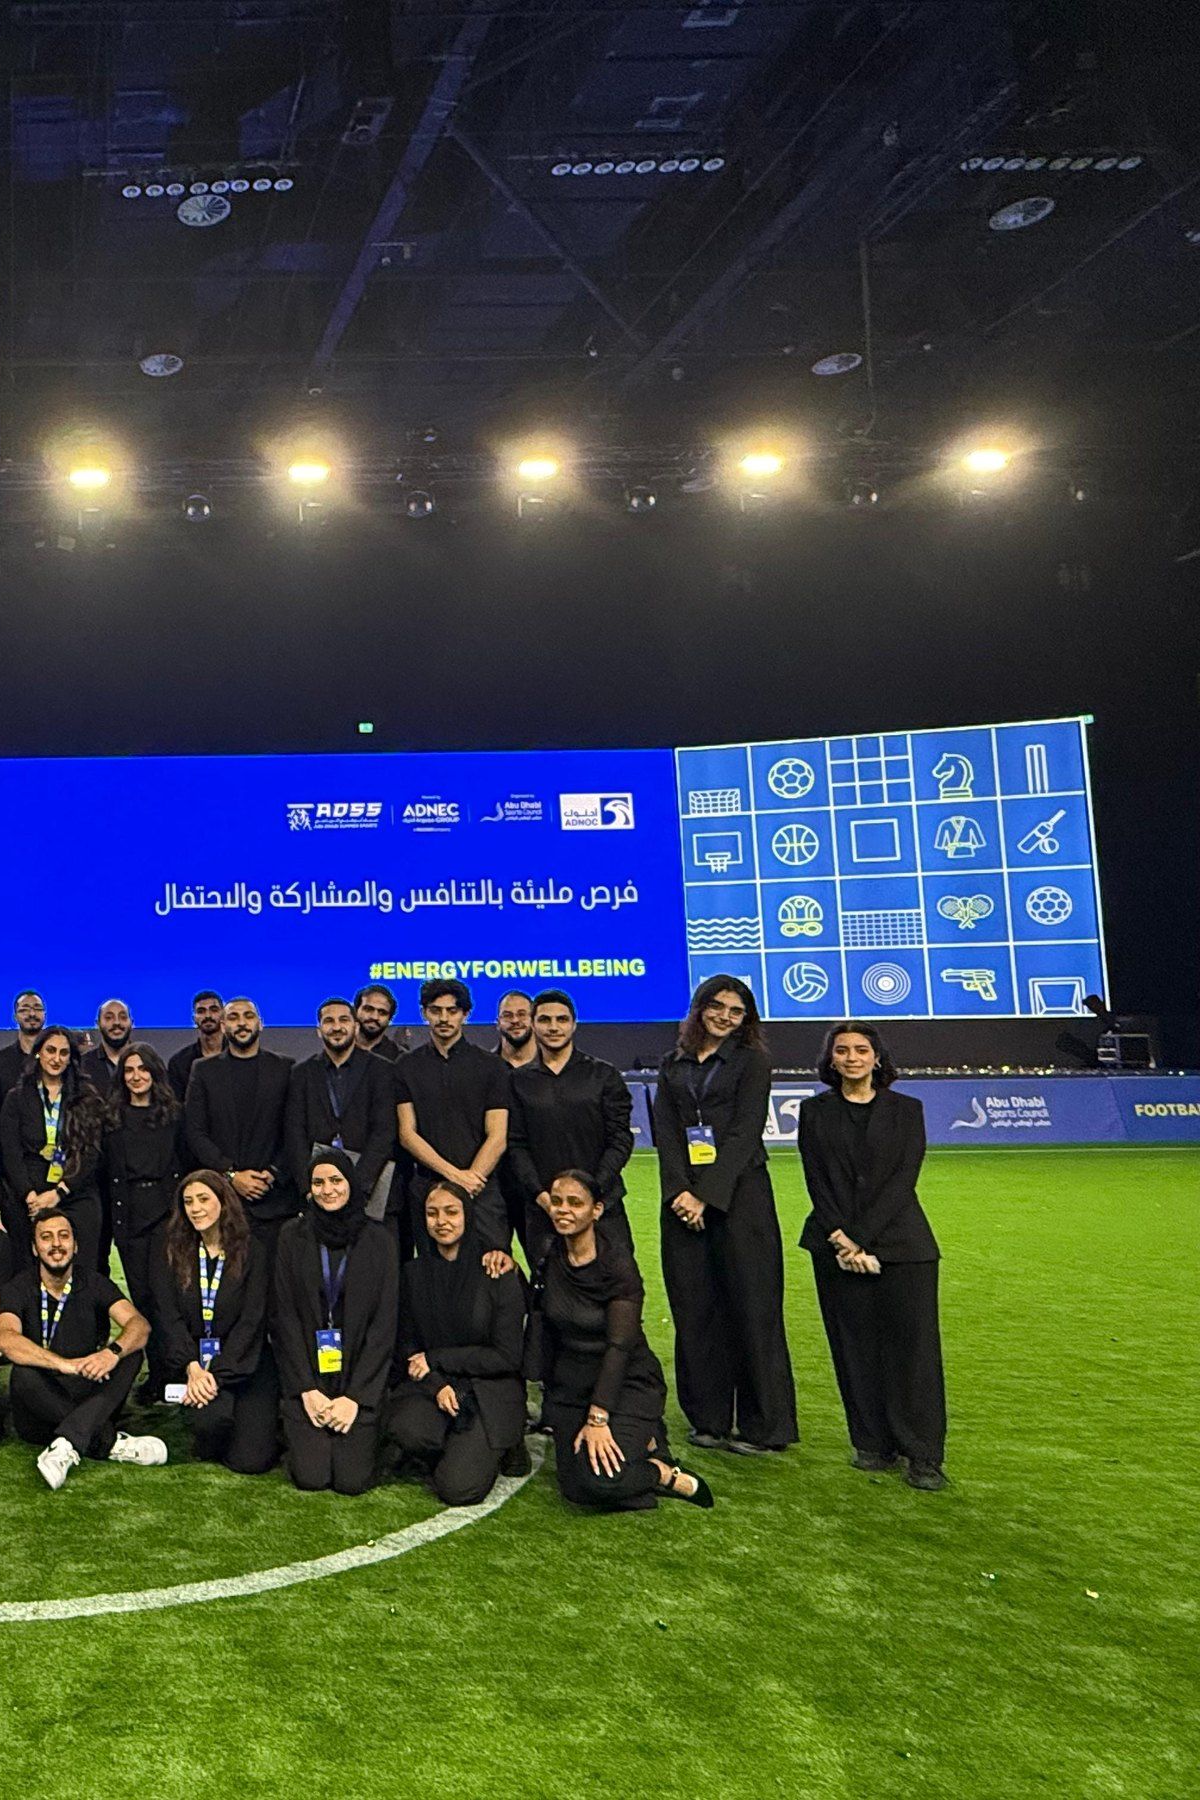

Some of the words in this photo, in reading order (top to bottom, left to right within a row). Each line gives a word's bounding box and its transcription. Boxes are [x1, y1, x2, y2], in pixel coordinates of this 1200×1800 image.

[316, 802, 383, 818] ADSS
[402, 803, 460, 817] ADNEC
[504, 801, 519, 809] Abu
[520, 801, 542, 809] Dhabi
[565, 818, 598, 826] ADNOC
[155, 882, 262, 915] والاحتفال
[270, 880, 394, 914] والمشاركة
[400, 879, 503, 912] بالتنافس
[511, 877, 574, 909] مليئة
[580, 879, 638, 911] فرص
[369, 958, 646, 980] #ENERGYFORWELLBEING
[986, 1096, 1010, 1108] Abu
[1010, 1096, 1046, 1108] Dhabi
[987, 1108, 1016, 1118] Sports
[1017, 1108, 1050, 1118] Council
